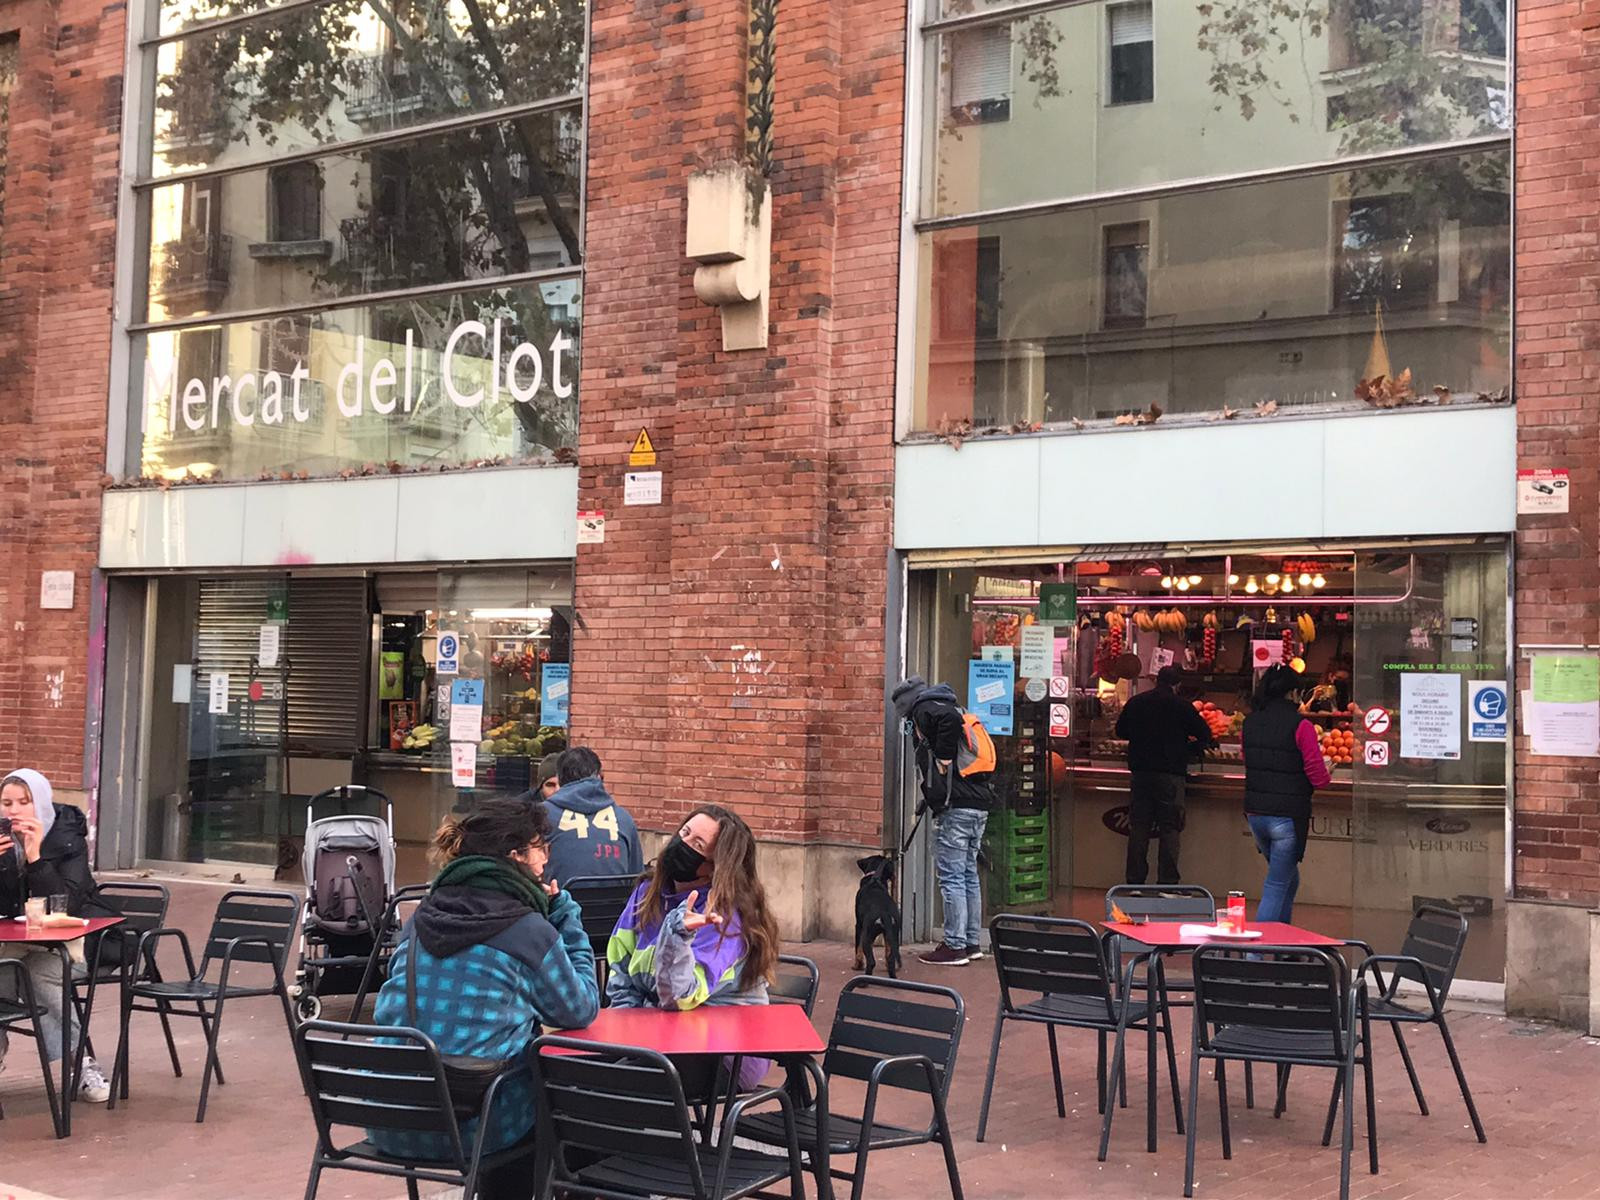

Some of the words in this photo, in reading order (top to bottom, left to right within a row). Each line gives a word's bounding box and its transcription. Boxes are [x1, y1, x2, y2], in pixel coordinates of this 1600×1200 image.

[142, 357, 311, 432] Mercat
[336, 329, 413, 418] del
[443, 319, 573, 409] Clot
[1436, 664, 1447, 672] DE
[1450, 664, 1471, 672] CASA
[559, 806, 618, 840] 44
[1408, 839, 1489, 853] VERDURES
